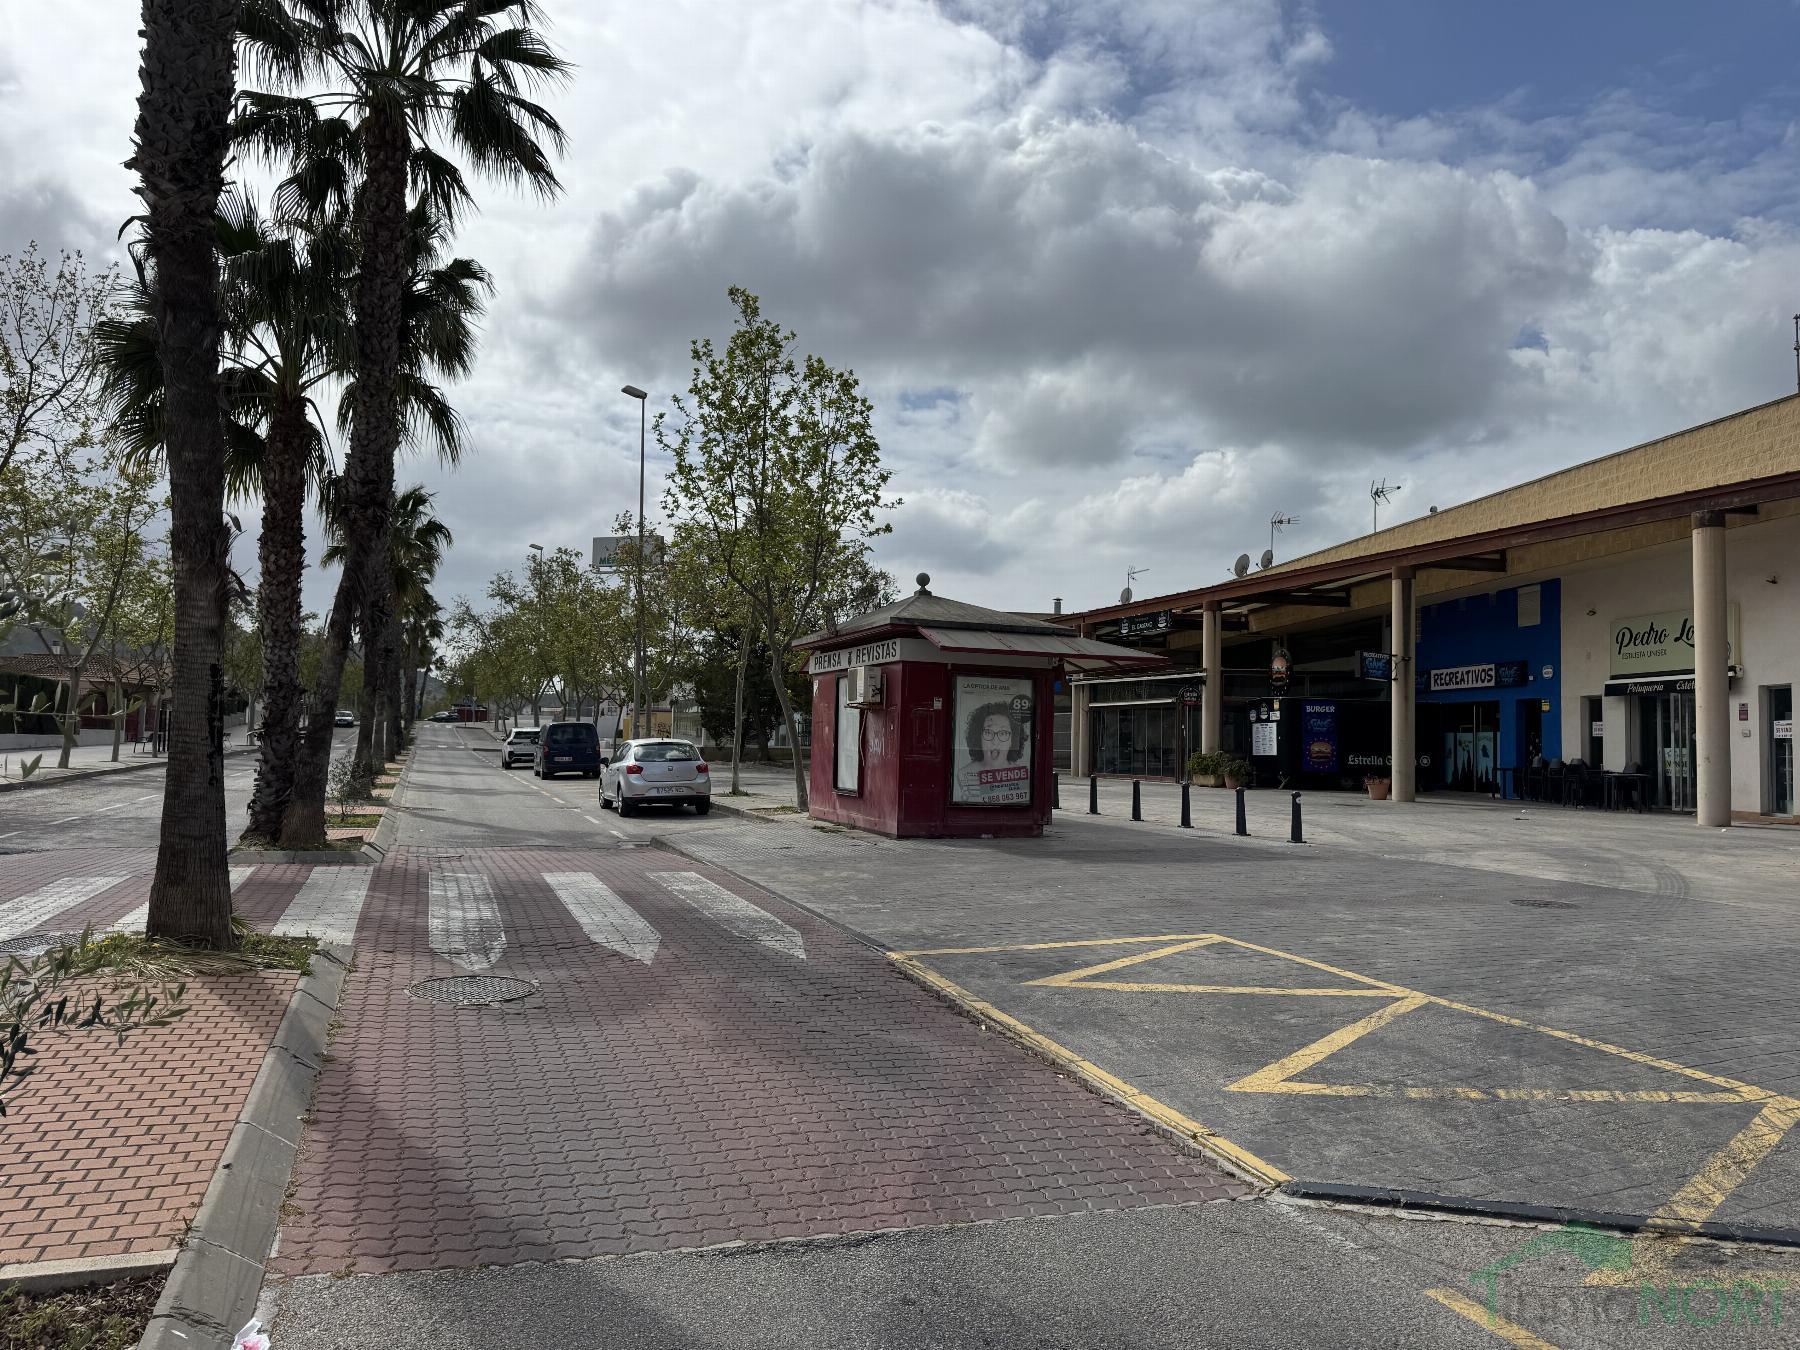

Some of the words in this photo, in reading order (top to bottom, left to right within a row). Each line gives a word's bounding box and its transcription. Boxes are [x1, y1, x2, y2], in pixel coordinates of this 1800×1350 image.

[1616, 621, 1669, 655] Pedro
[815, 651, 842, 671] PRENSA
[856, 641, 897, 665] REVISTAS
[1647, 649, 1667, 658] UNISEX
[1433, 668, 1494, 687] RECREATIVOS
[1305, 705, 1335, 713] BURGER
[1348, 755, 1383, 765] Estrella
[981, 773, 993, 783] SE
[996, 769, 1027, 781] VENDE
